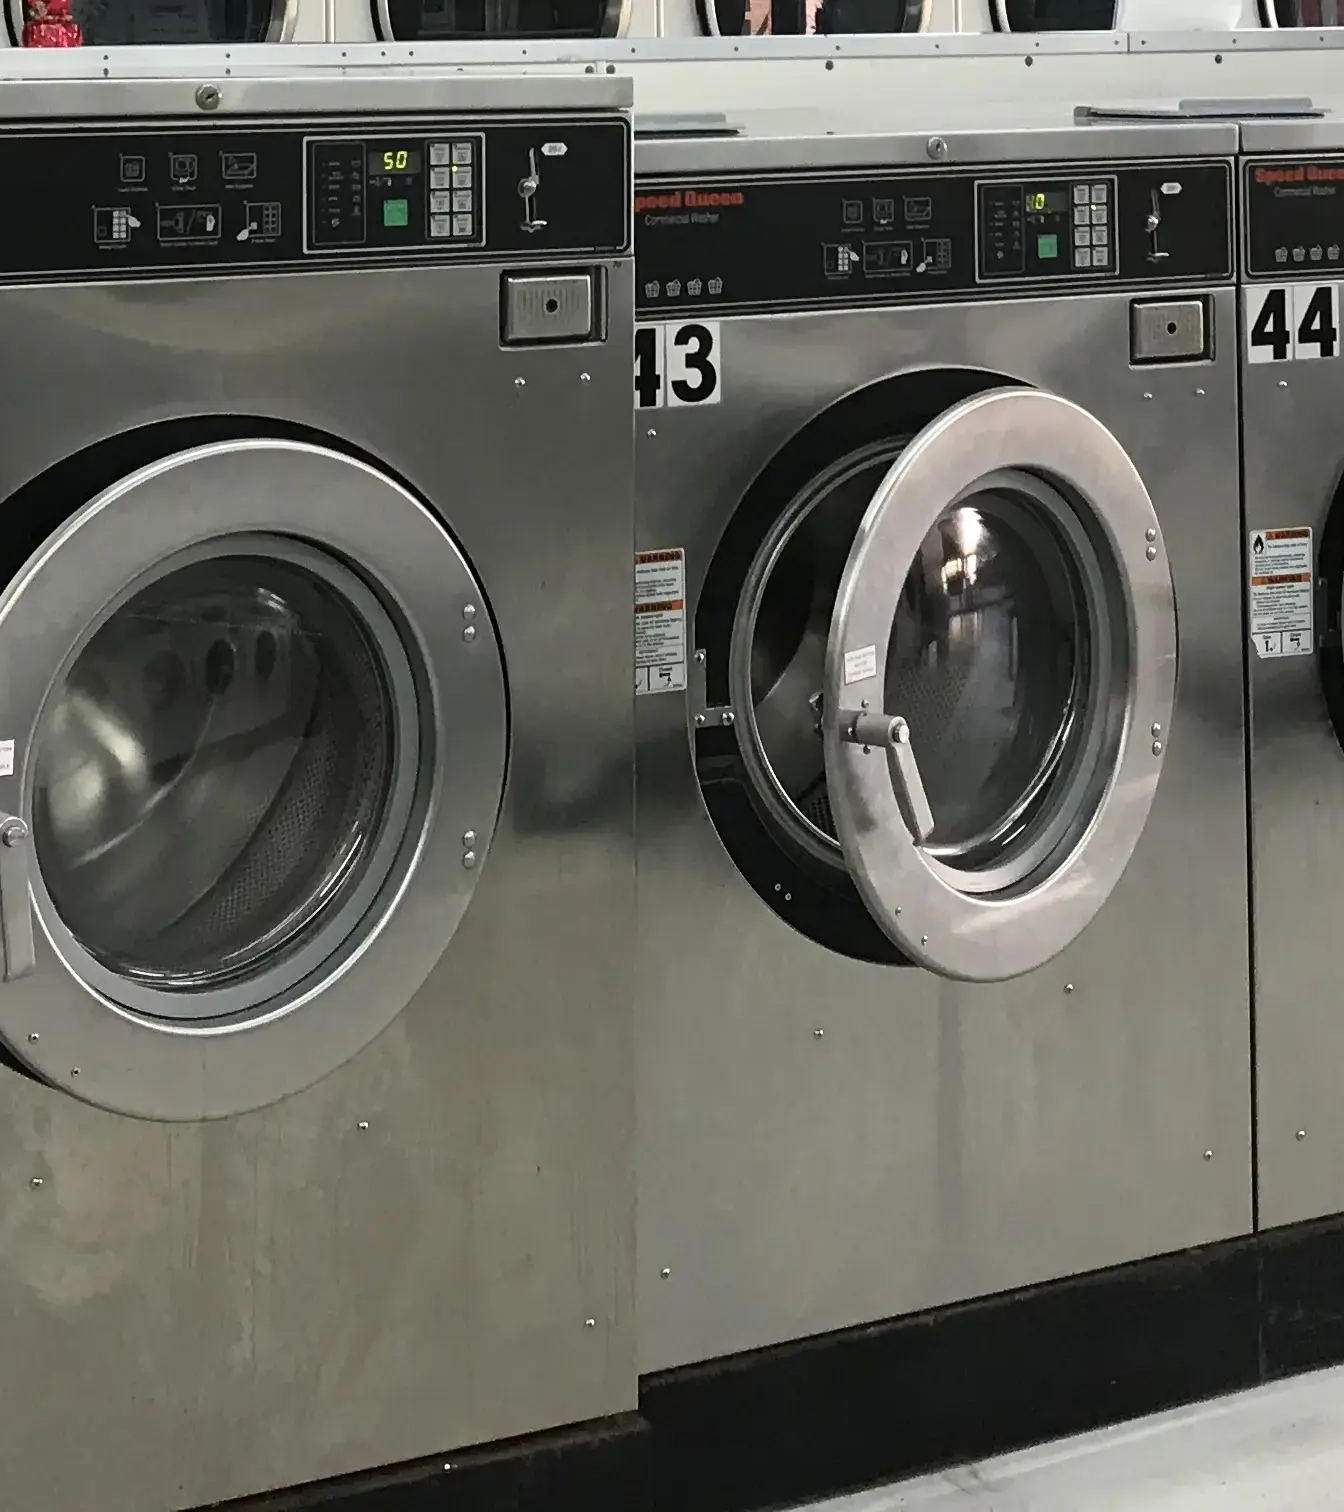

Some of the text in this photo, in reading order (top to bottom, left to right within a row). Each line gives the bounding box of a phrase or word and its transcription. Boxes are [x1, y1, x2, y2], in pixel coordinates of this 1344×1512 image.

[383, 150, 408, 170] 50
[634, 190, 744, 212] peed Queen
[1251, 287, 1337, 361] 44
[634, 322, 717, 408] 43
